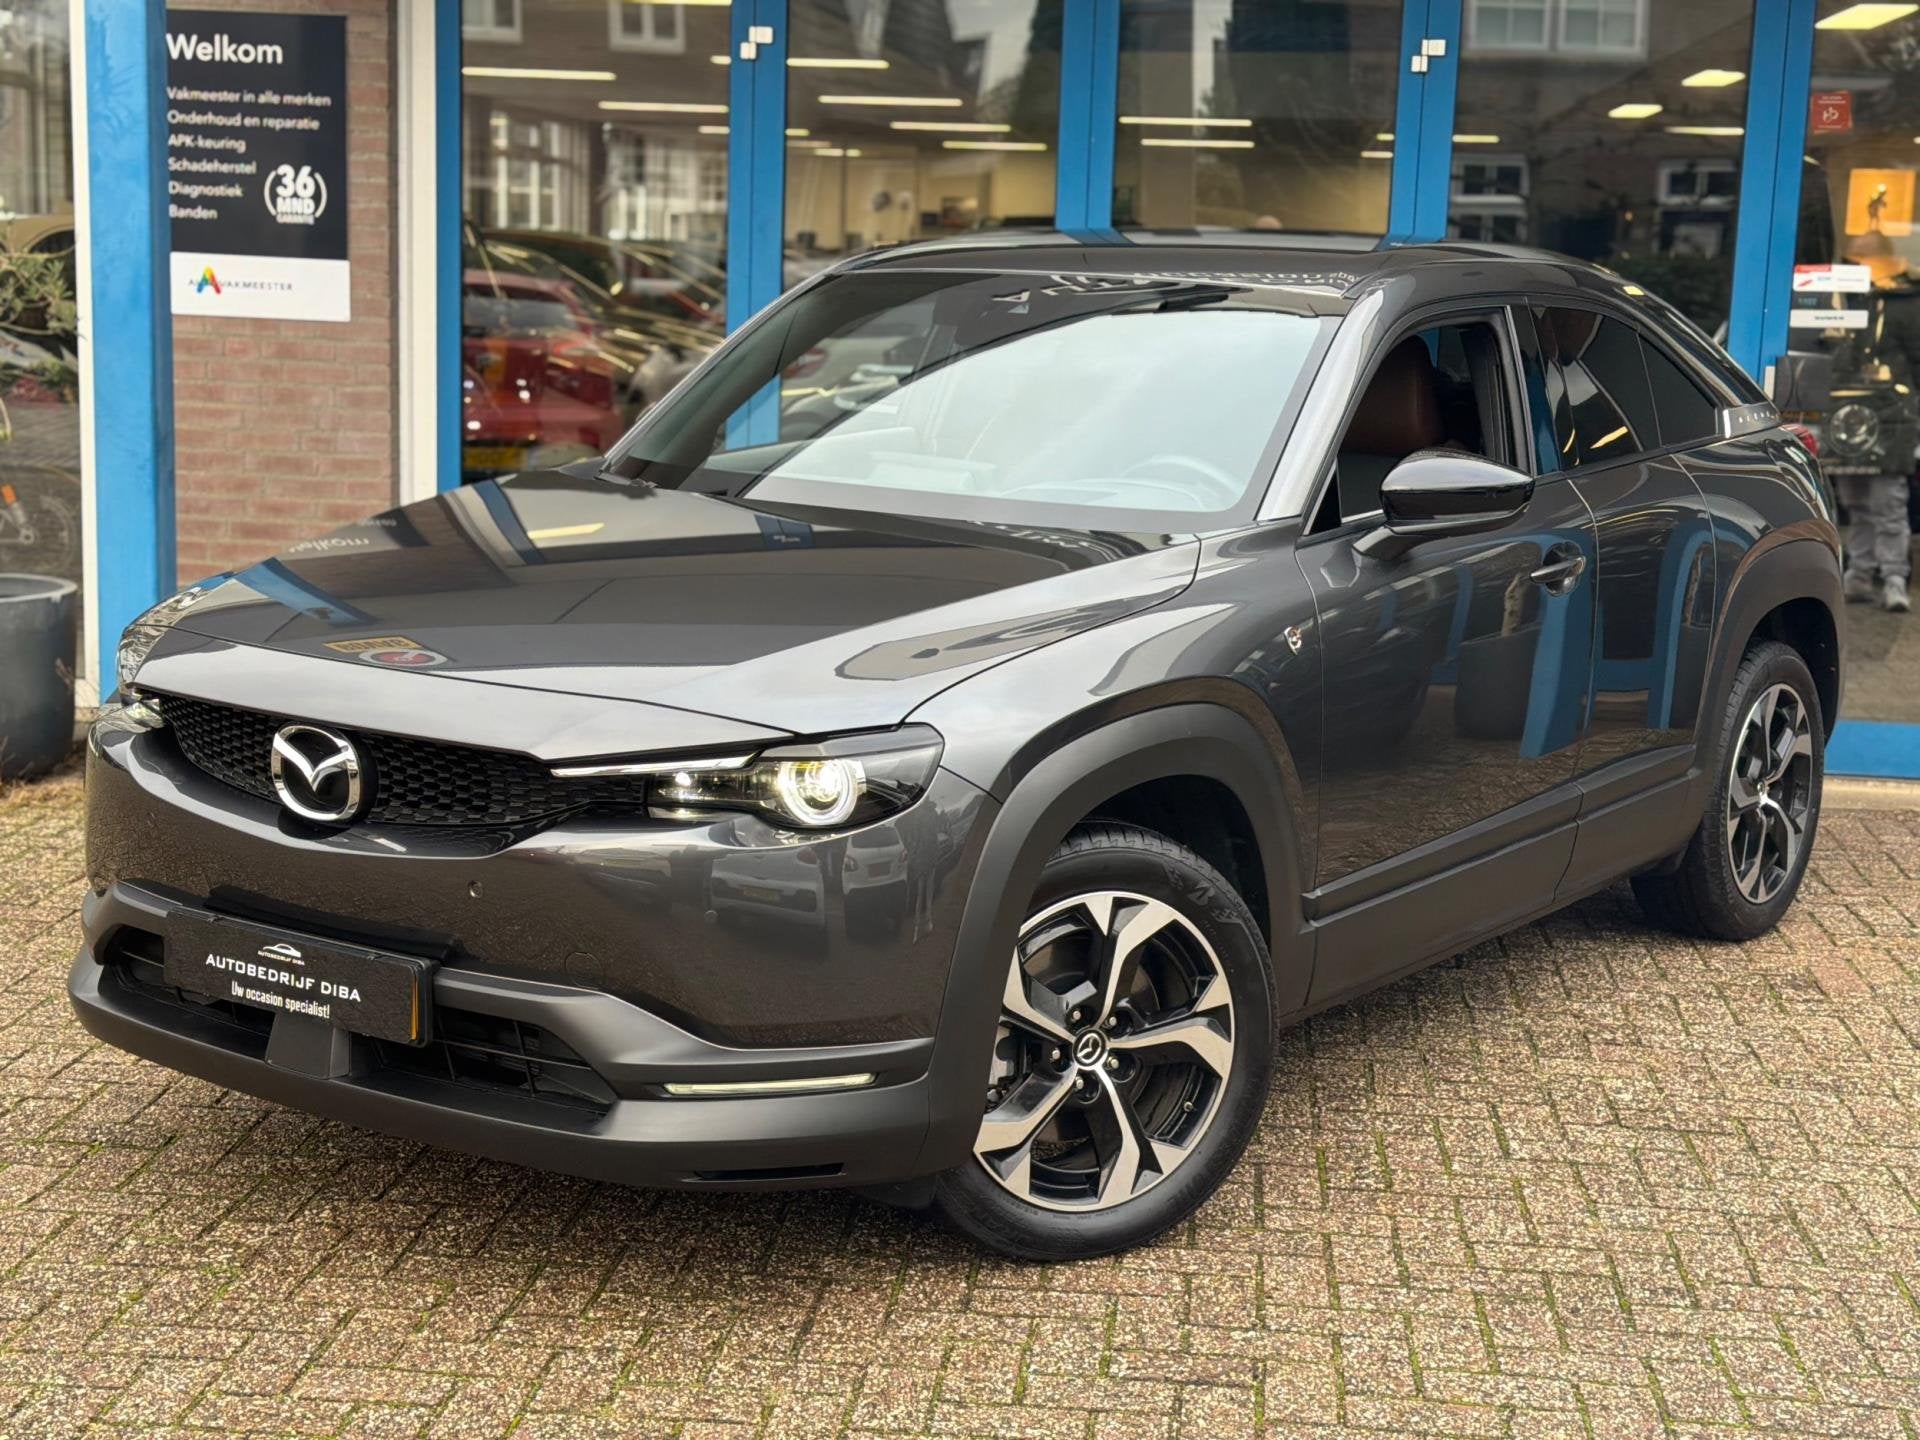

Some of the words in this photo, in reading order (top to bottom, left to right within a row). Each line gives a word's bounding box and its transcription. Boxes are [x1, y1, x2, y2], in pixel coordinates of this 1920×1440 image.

[166, 33, 283, 64] Welkom
[167, 87, 240, 104] Vakmeester
[243, 90, 255, 104] in
[258, 91, 280, 105] alle
[283, 93, 331, 107] merken
[167, 110, 242, 127] Onderhoud
[244, 116, 260, 127] en
[262, 116, 320, 131] reparatie
[168, 134, 246, 153] APK-keuring
[168, 157, 256, 174] Schadeherstel
[168, 181, 243, 198] Diagnostiek
[276, 164, 316, 198] 36
[169, 205, 217, 220] Banden
[276, 197, 316, 215] MND
[205, 954, 315, 990] AUTOBEDRIJF
[320, 980, 361, 1002] DIBA
[231, 981, 244, 997] Uw
[245, 987, 283, 1006] occasion
[285, 992, 331, 1019] specialist!
